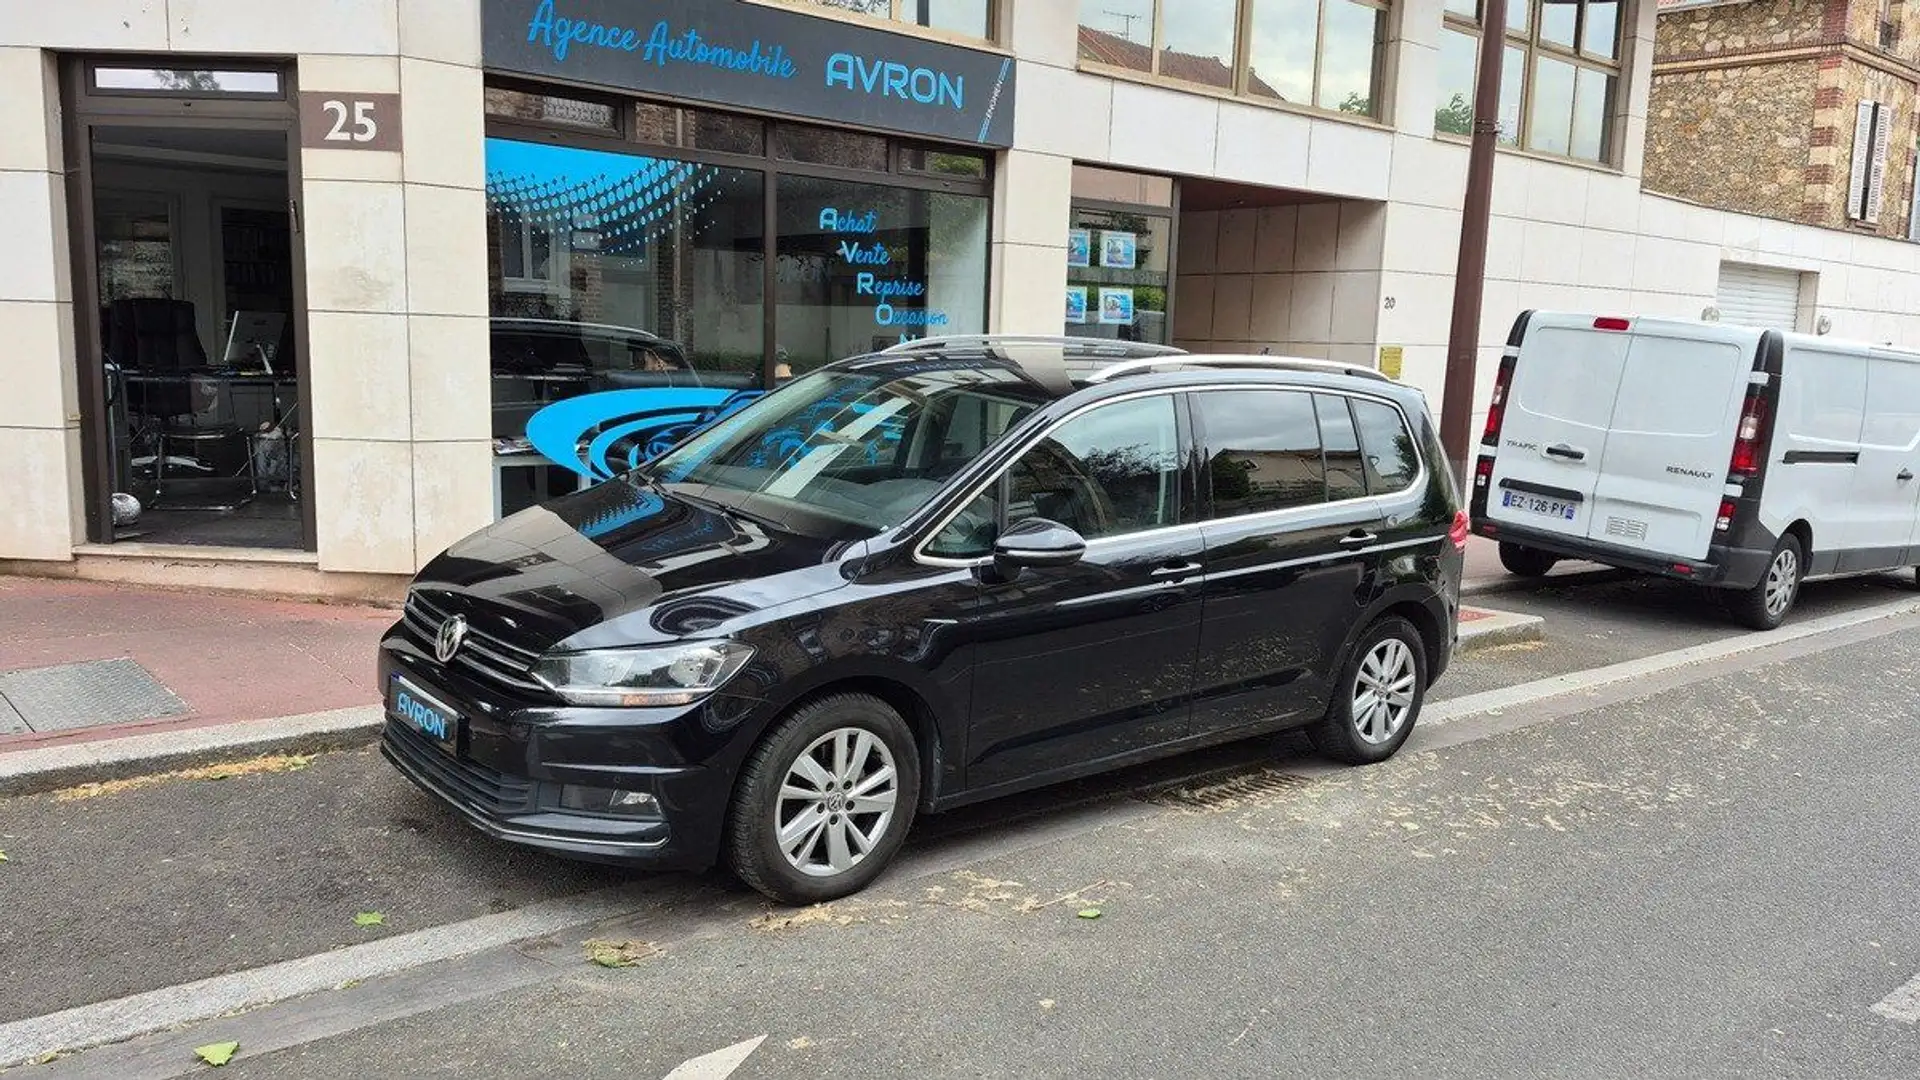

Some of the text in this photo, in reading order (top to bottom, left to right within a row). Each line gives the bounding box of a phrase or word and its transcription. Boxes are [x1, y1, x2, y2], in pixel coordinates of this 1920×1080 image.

[527, 0, 798, 79] Agence Automobile
[826, 52, 963, 109] AVRON
[323, 100, 377, 142] 25
[819, 207, 877, 233] Achat
[840, 240, 891, 265] Vente
[857, 272, 925, 304] Reprise
[875, 303, 948, 326] Occasion
[1384, 296, 1397, 310] 20
[1666, 466, 1714, 479] RENAULT
[398, 692, 445, 739] AVRON
